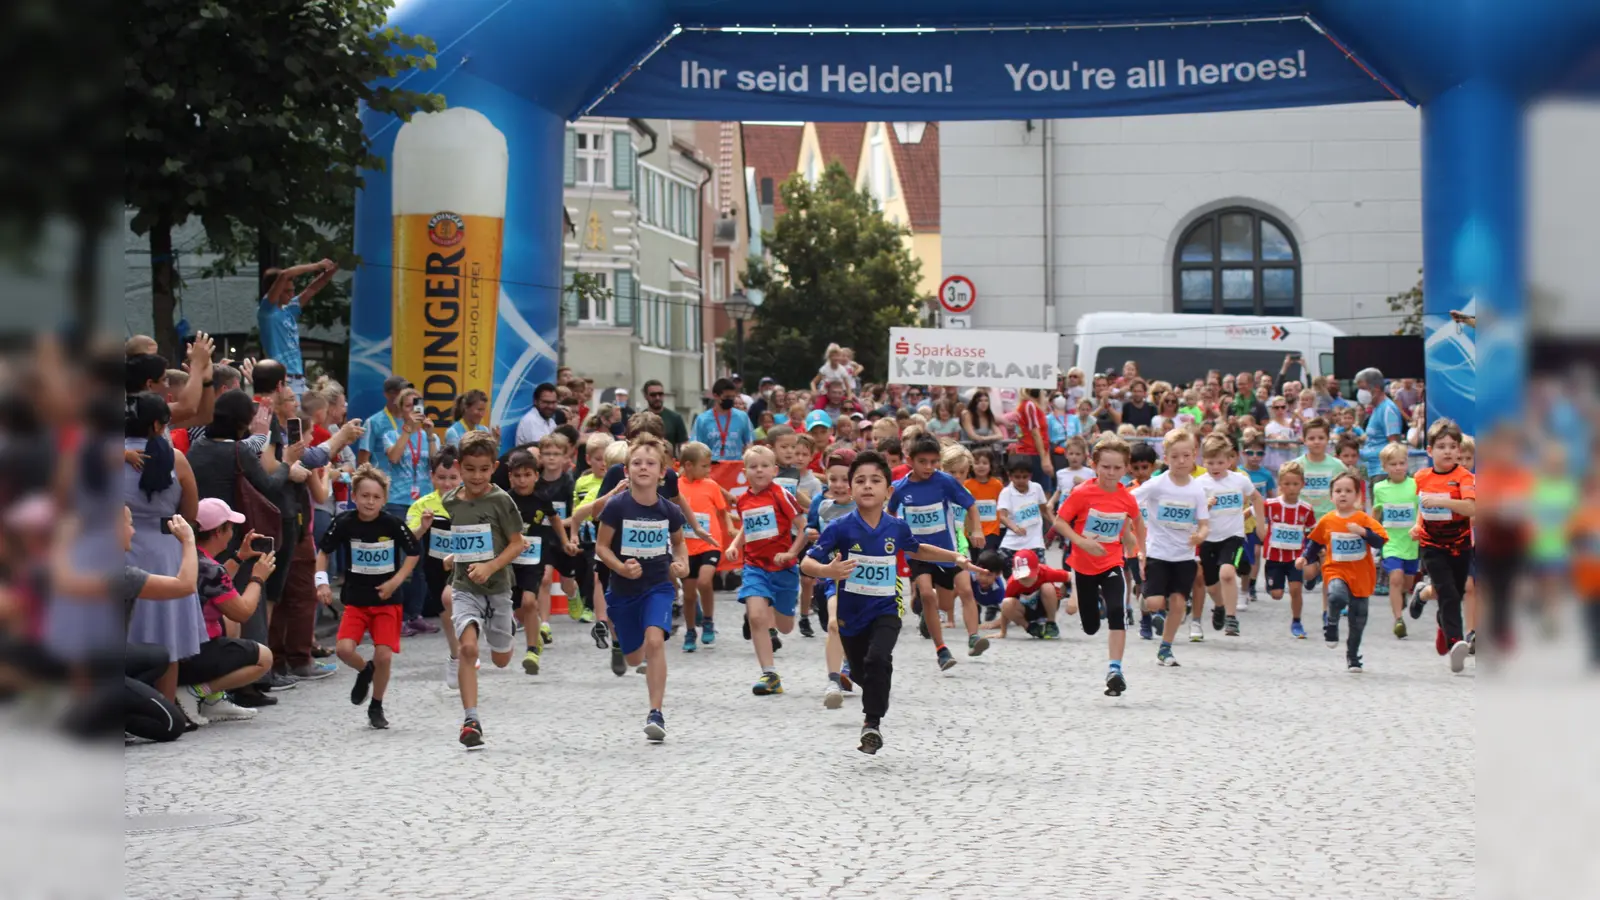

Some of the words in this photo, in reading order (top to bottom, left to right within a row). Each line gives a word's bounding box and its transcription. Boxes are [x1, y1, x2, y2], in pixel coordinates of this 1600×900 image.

[680, 61, 727, 89] Ihr
[737, 64, 809, 92] seid
[821, 64, 953, 93] Helden!
[1004, 61, 1116, 91] You're
[1126, 59, 1166, 88] all
[1177, 49, 1307, 85] heroes!
[468, 261, 481, 379] ALKOHOLFREI
[423, 247, 466, 428] RDINGER
[913, 343, 986, 358] Sparkasse
[911, 511, 940, 524] 2035
[1162, 507, 1191, 519] 2059
[1387, 509, 1411, 519] 2045
[744, 514, 770, 530] 2043
[1092, 519, 1119, 533] 2071
[456, 535, 485, 550] 2073
[628, 529, 664, 543] 2006
[1336, 540, 1362, 551] 2023
[356, 549, 389, 562] 2060
[855, 565, 889, 581] 2051
